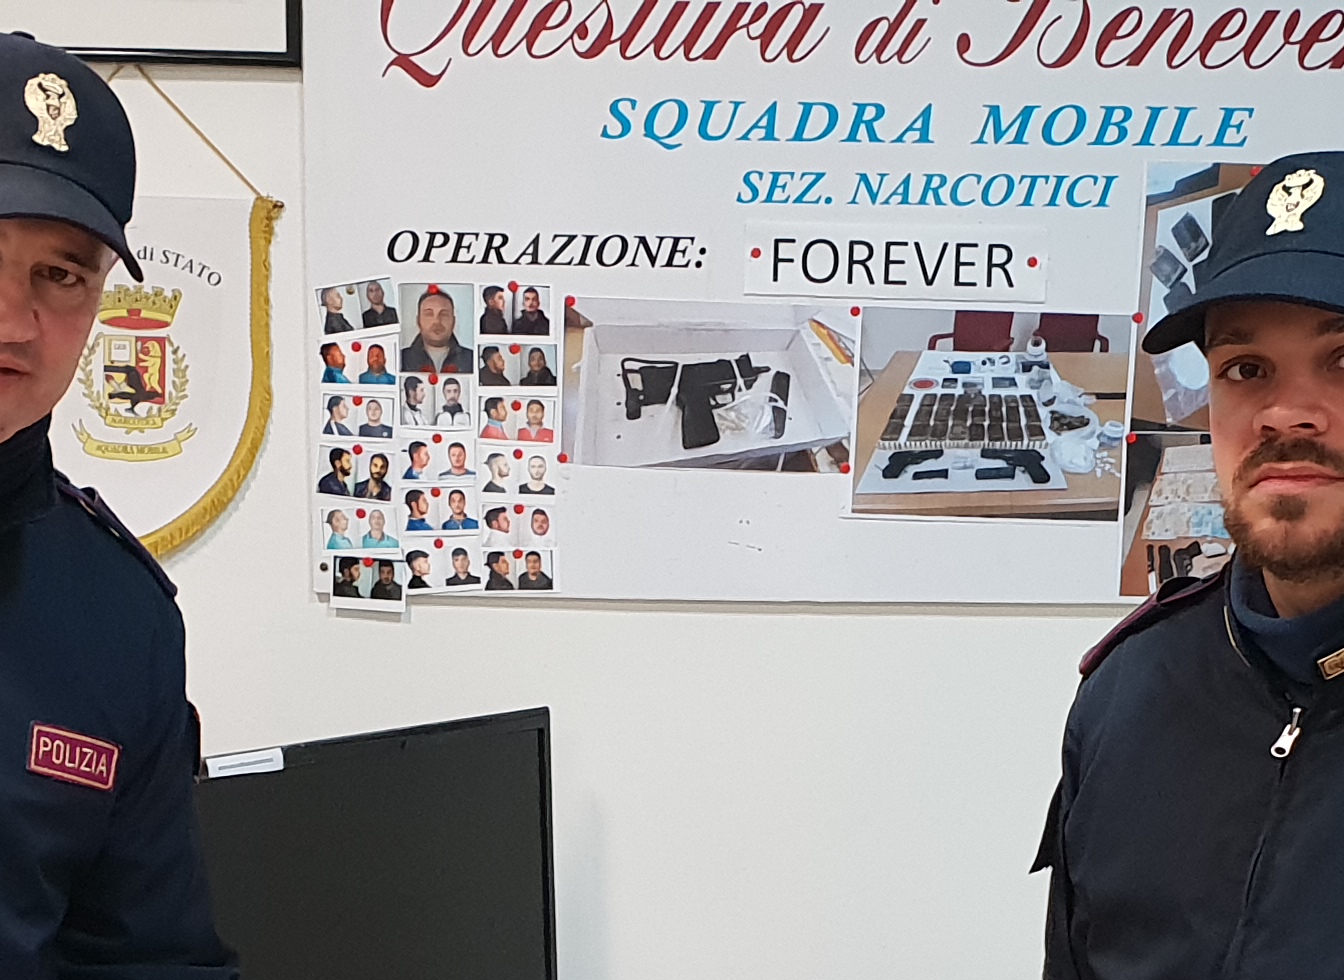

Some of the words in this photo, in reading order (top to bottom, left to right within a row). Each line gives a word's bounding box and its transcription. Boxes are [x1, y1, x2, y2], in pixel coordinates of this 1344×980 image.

[600, 97, 936, 150] SQUADRA
[971, 104, 1255, 148] MOBILE
[737, 170, 833, 205] SEZ.
[847, 172, 1119, 208] NARCOTICI
[137, 246, 154, 261] di
[160, 249, 222, 287] STATO
[386, 229, 707, 270] OPERAZIONE:
[772, 238, 1014, 289] FOREVER
[39, 736, 107, 778] POLIZIA
